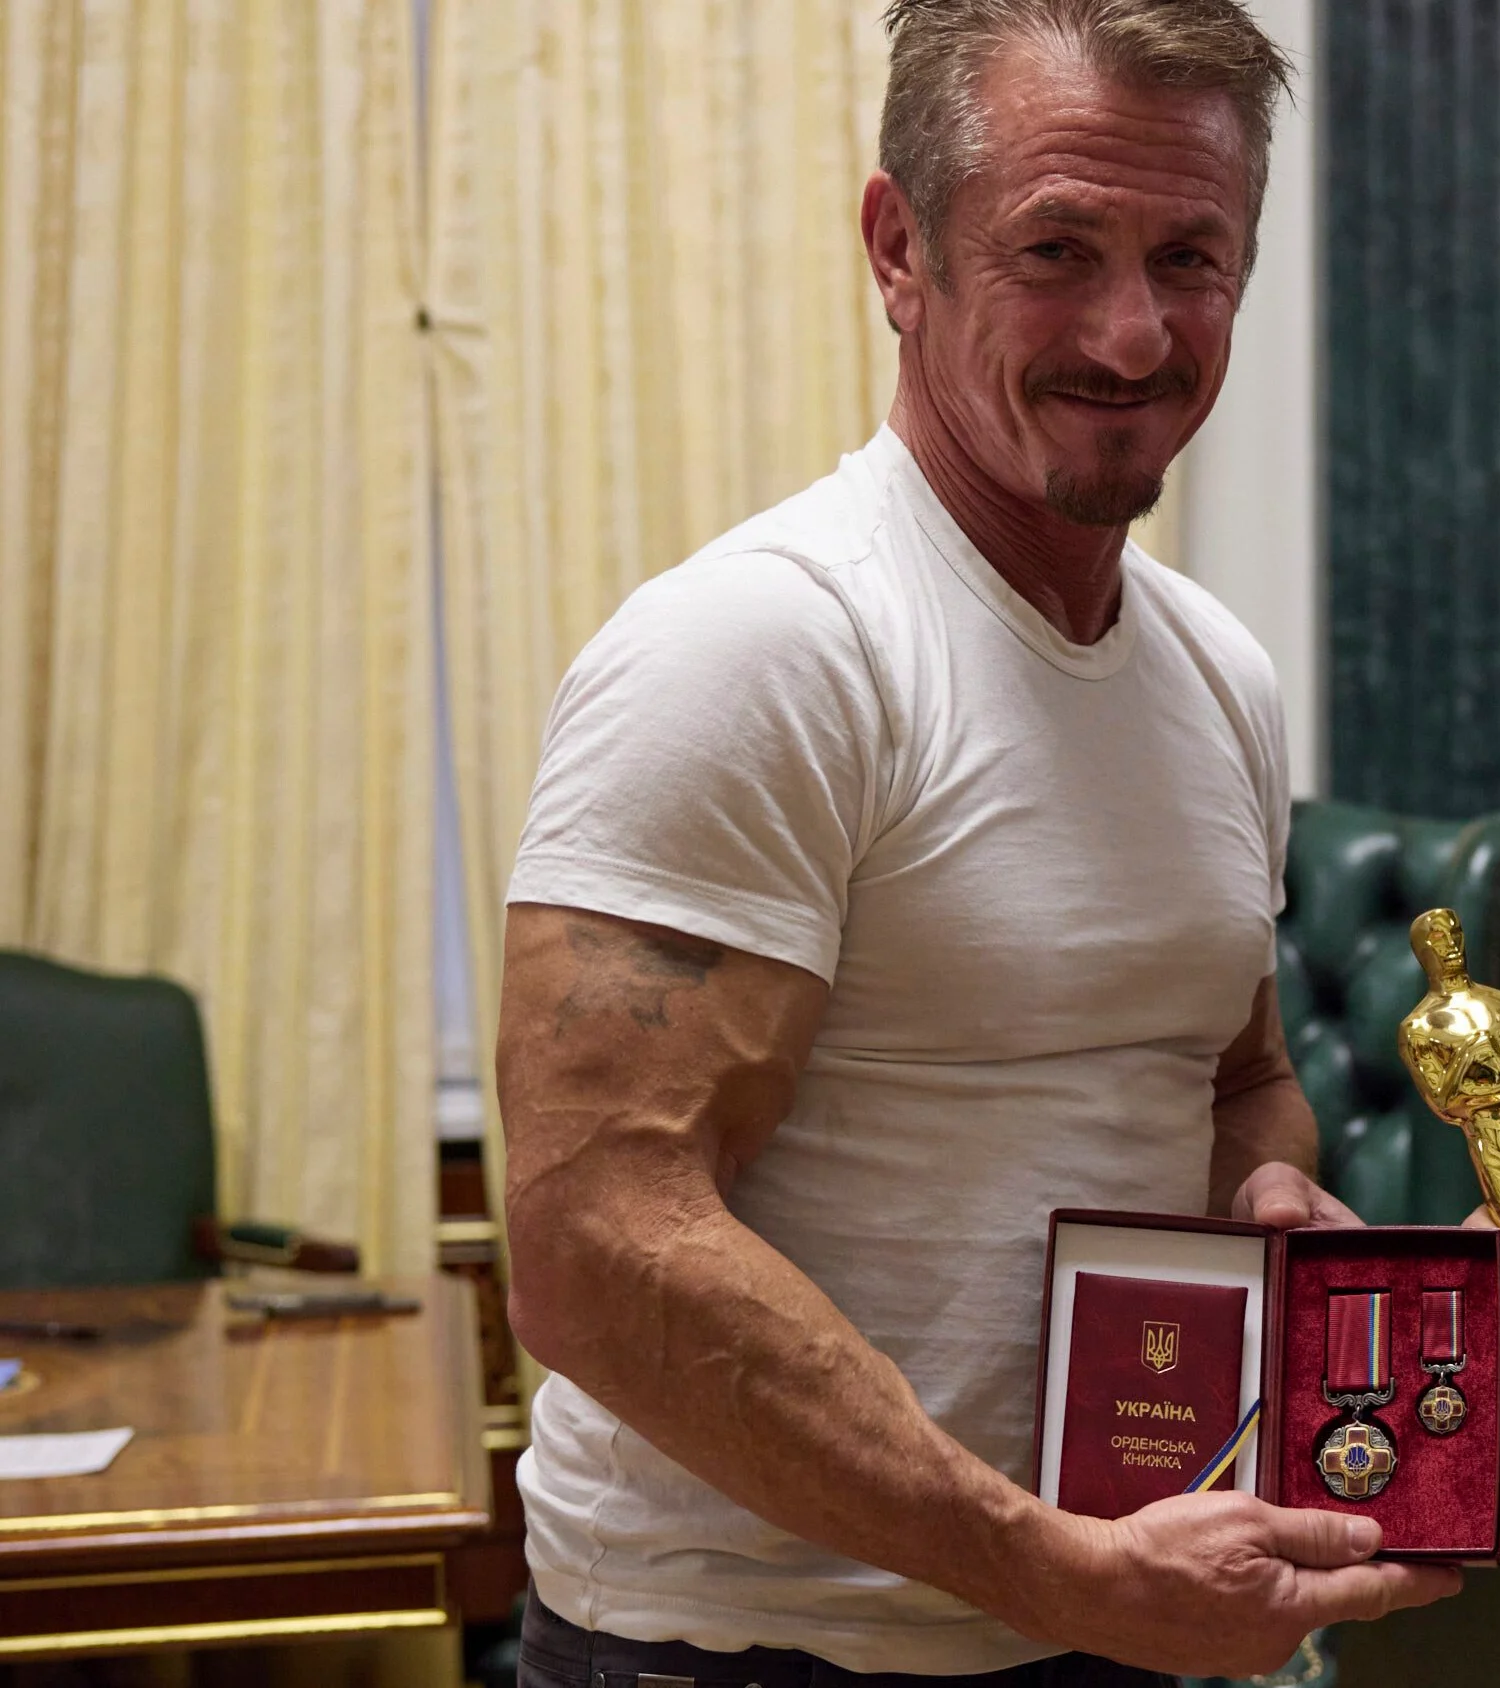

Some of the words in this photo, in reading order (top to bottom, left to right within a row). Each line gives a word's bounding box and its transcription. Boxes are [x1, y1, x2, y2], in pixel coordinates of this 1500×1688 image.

[1115, 1400, 1196, 1422] УКРАЇНА
[1111, 1435, 1196, 1454] ОРДЕНСЬКА
[1122, 1452, 1181, 1470] КНИЖКА
